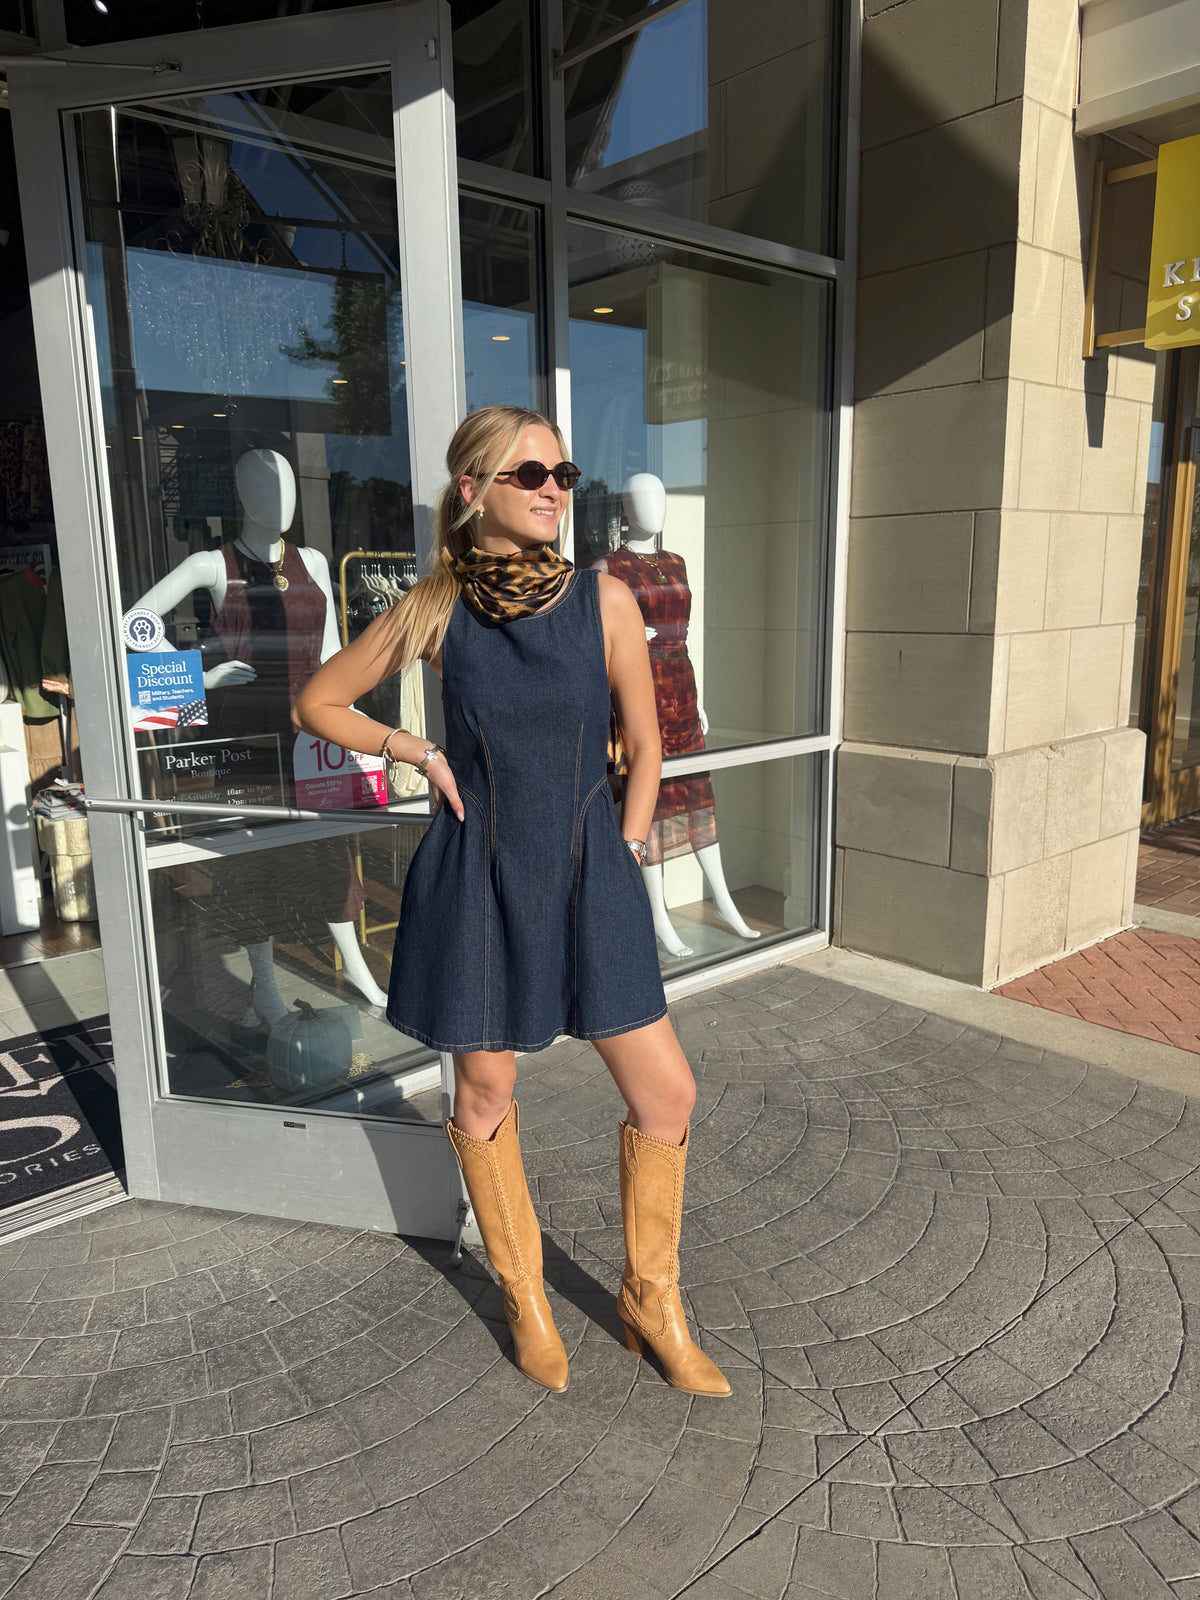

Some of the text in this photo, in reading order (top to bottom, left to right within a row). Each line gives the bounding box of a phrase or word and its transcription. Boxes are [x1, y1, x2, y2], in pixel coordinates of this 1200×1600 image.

[141, 660, 187, 677] Special
[137, 674, 194, 688] Discount
[165, 748, 253, 770] Parker Post
[309, 740, 365, 771] 10 OFF
[190, 767, 232, 780] Boutique
